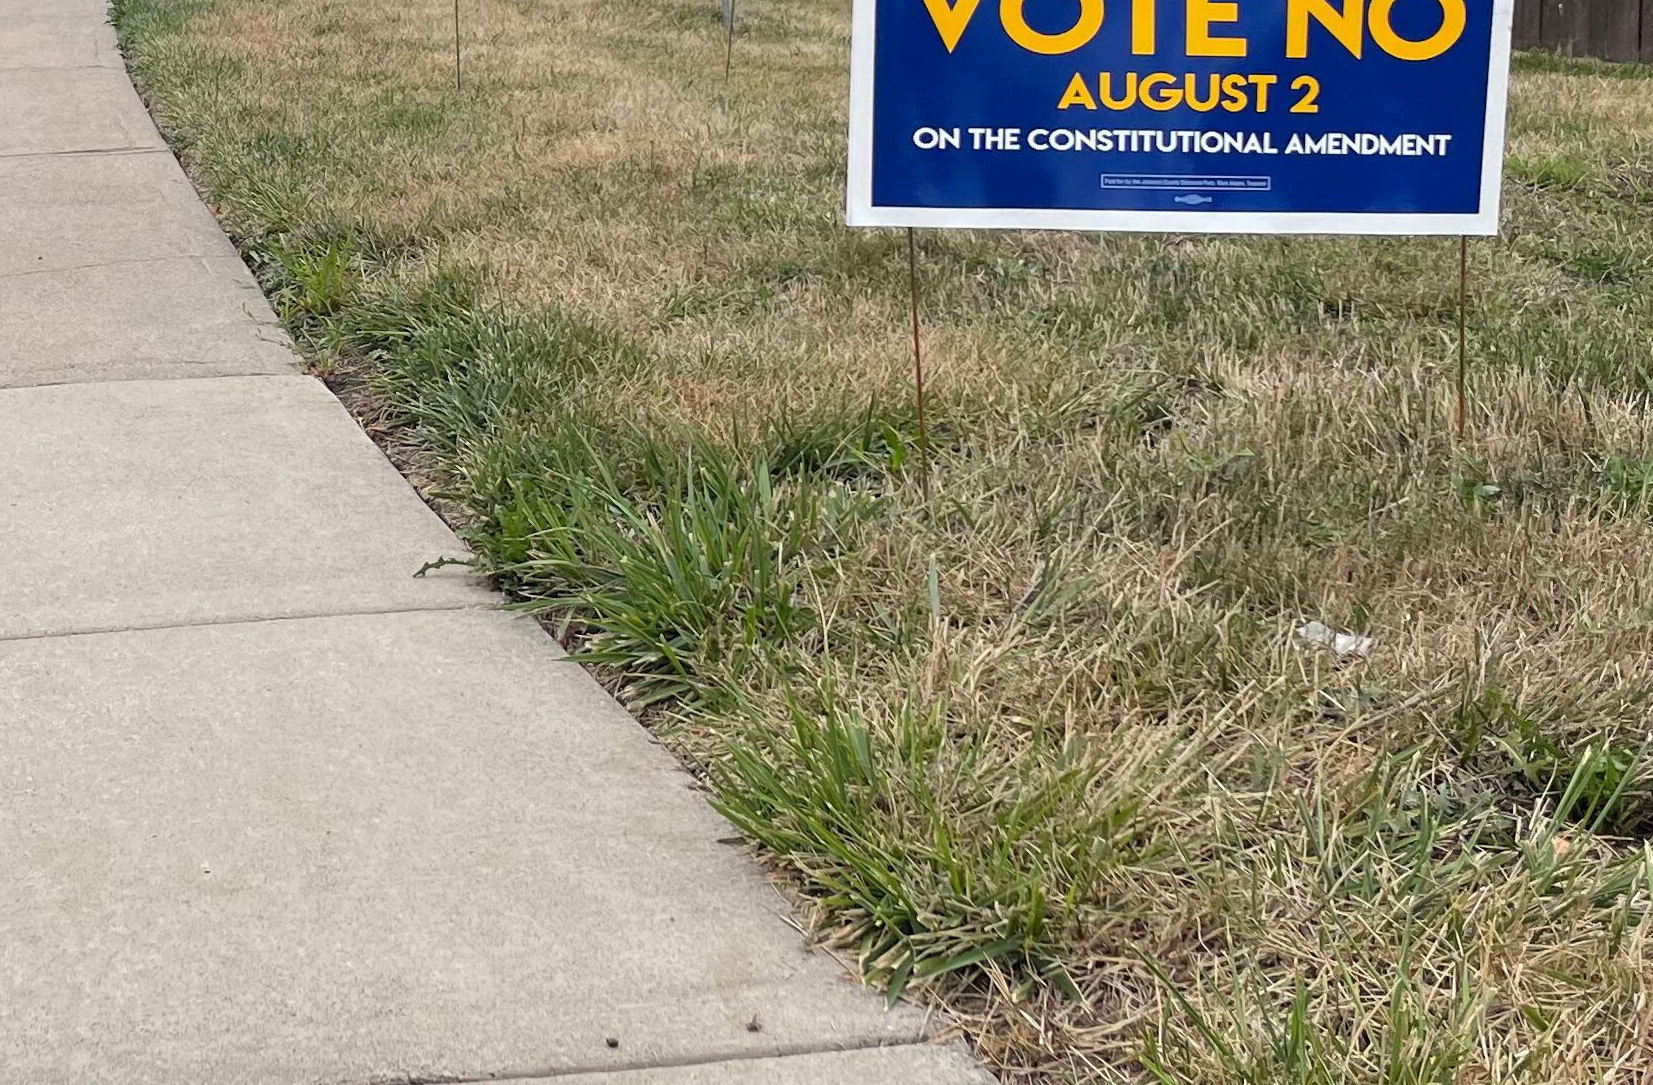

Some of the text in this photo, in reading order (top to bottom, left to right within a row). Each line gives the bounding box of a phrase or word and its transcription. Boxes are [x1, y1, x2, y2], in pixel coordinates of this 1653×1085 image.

[1057, 71, 1320, 113] AUGUST 2
[912, 127, 1452, 157] ON THE CONSTITUTIONAL AMENDMENT
